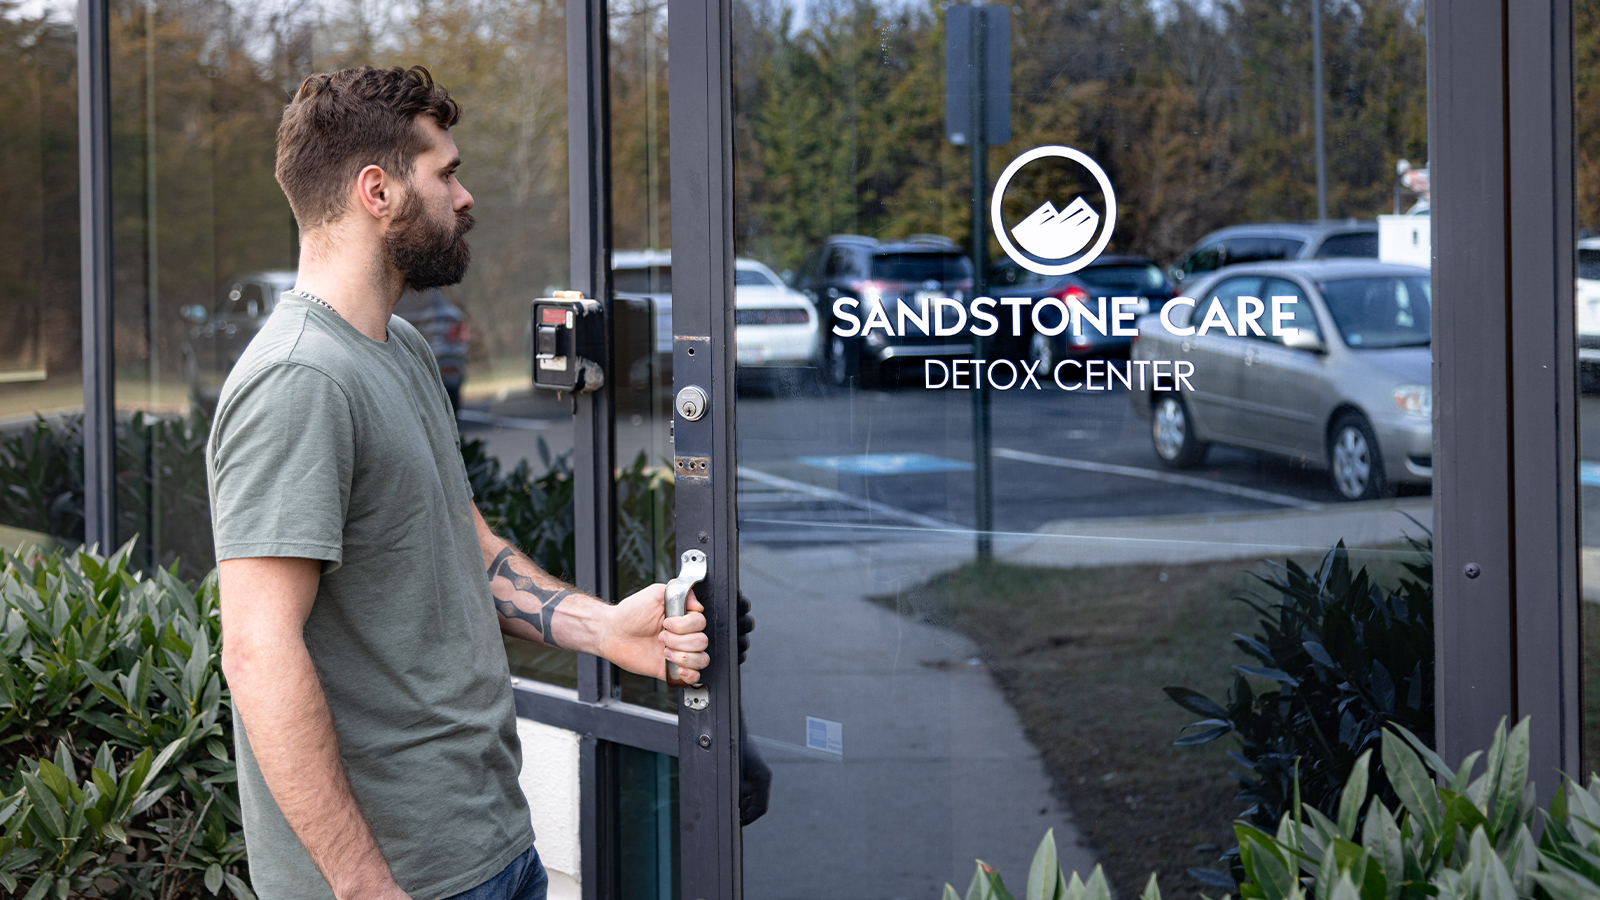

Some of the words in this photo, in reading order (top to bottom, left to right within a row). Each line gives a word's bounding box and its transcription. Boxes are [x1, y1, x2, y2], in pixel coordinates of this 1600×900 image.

[832, 296, 1139, 337] SANDSTONE
[1159, 296, 1299, 337] CARE
[925, 359, 1042, 390] DETOX
[1053, 359, 1196, 391] CENTER
